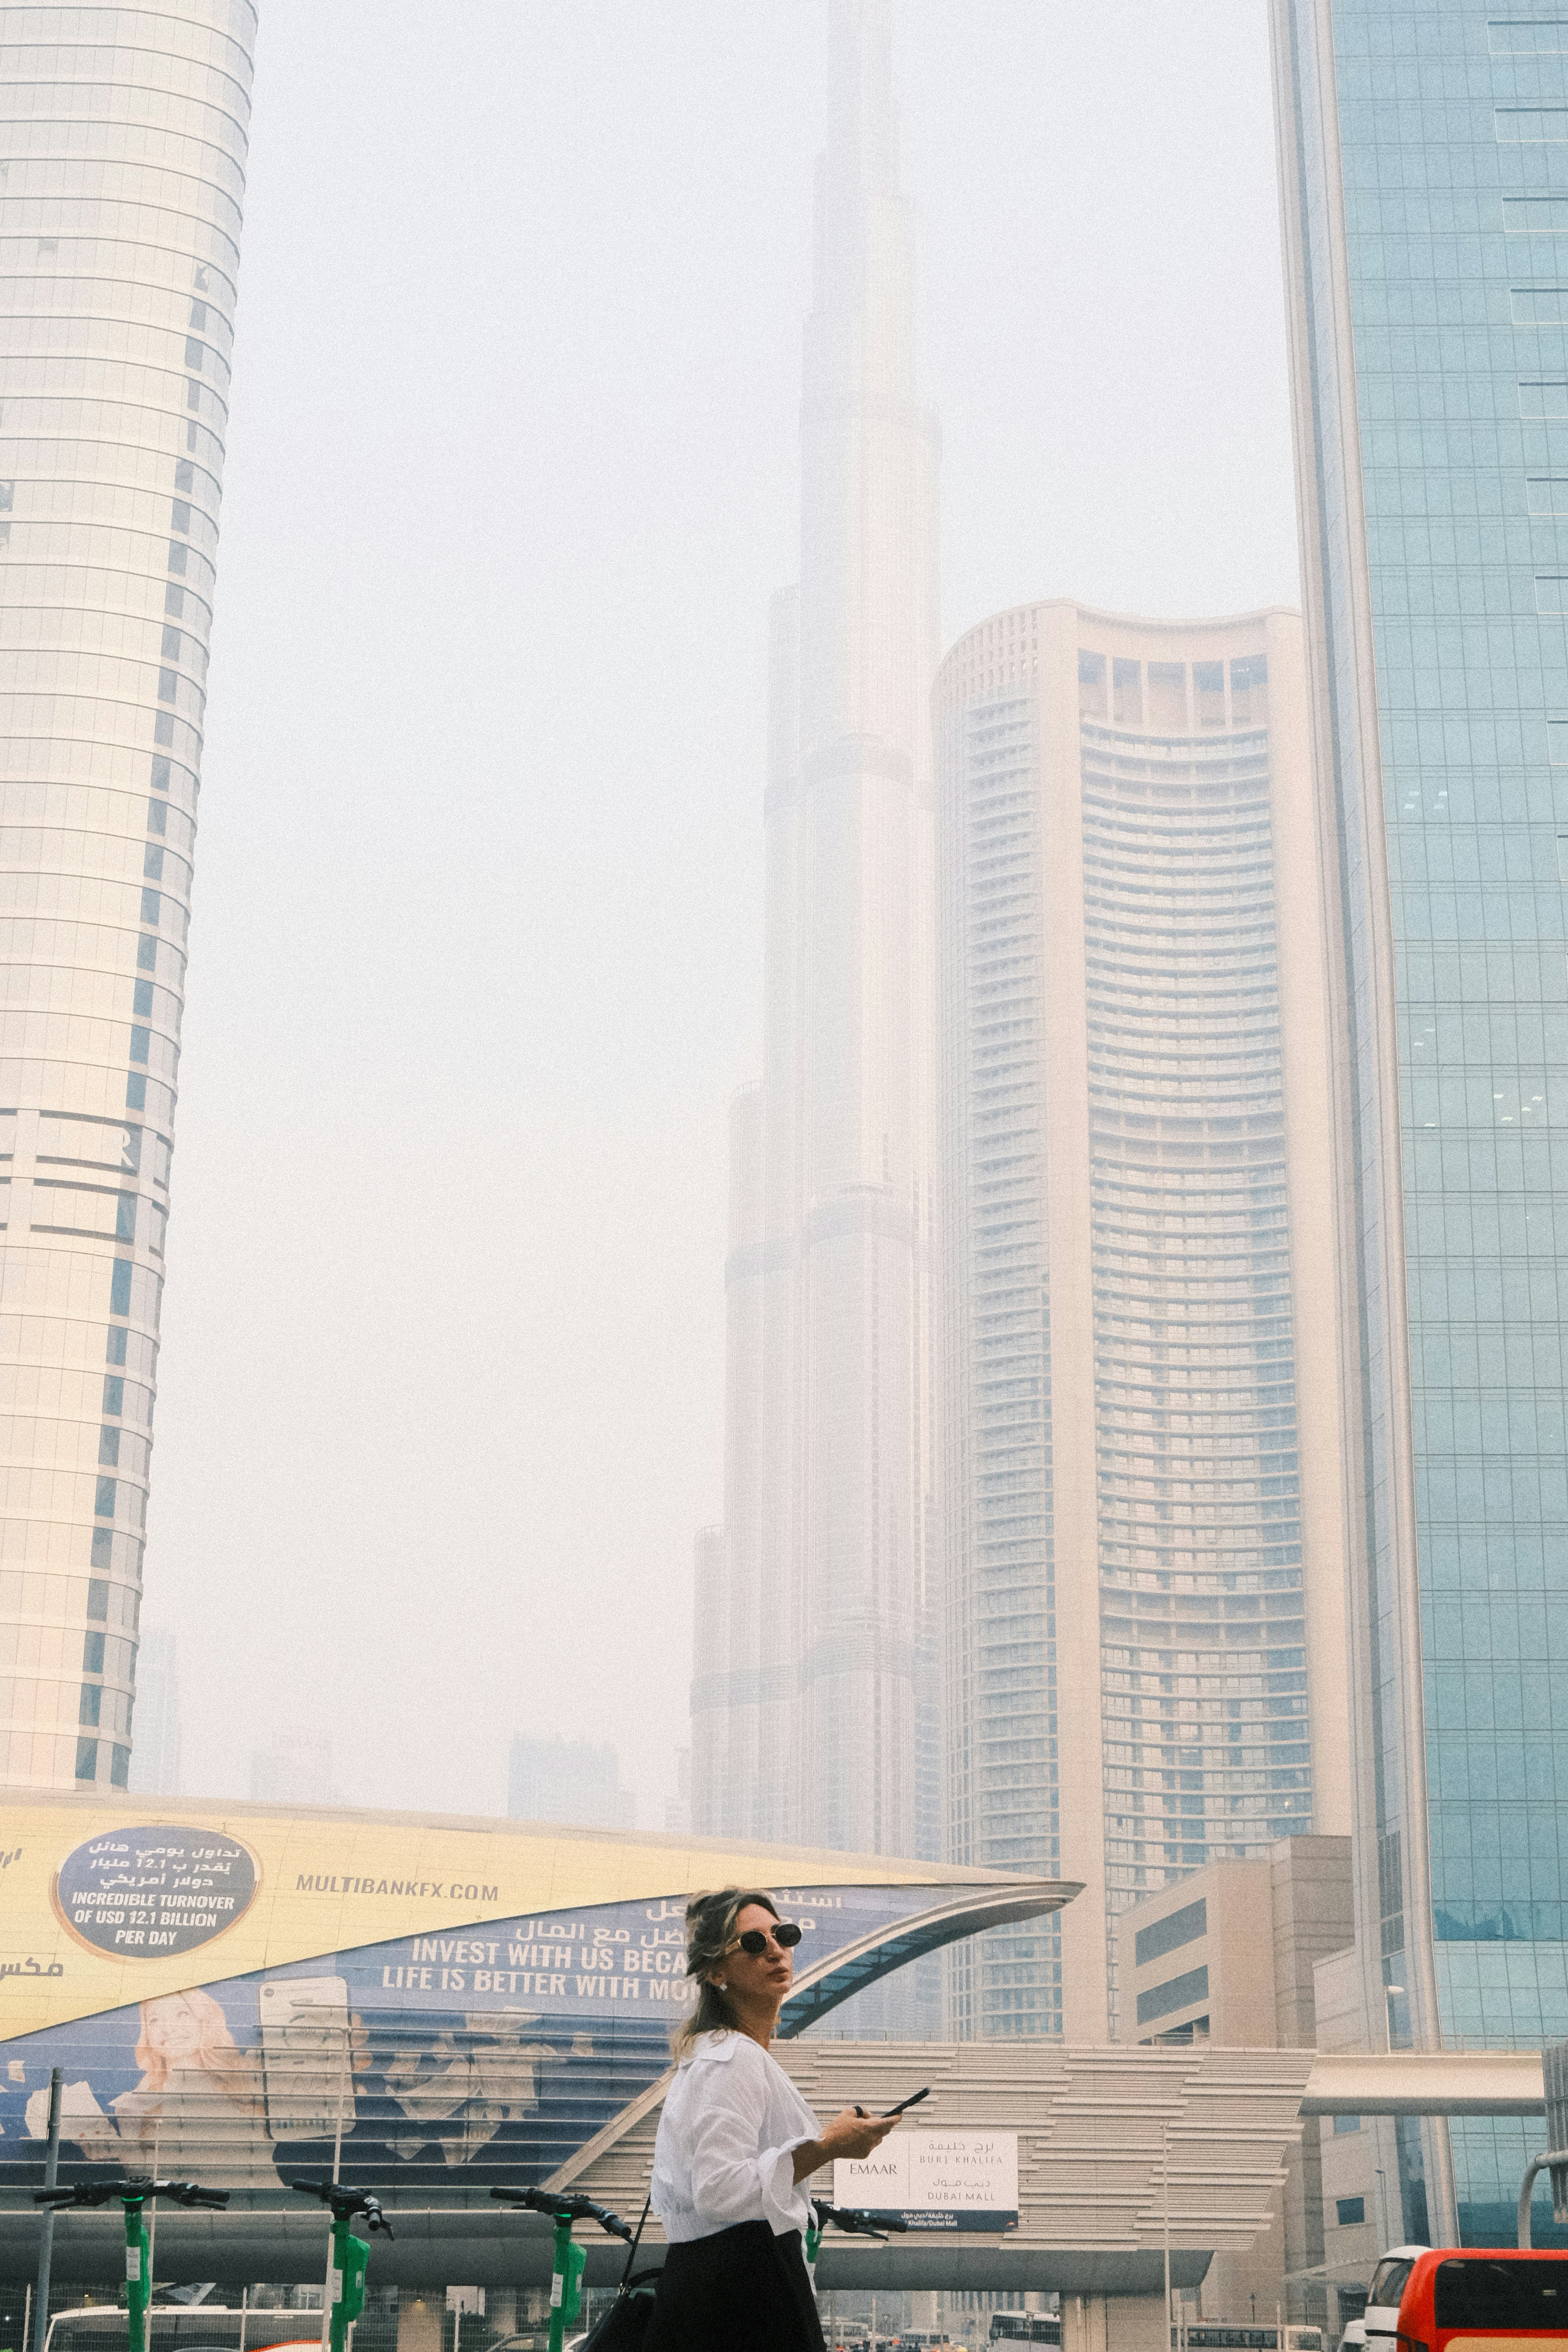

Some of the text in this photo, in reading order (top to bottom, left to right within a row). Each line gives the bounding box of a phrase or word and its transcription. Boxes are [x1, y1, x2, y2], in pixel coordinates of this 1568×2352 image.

[89, 1841, 242, 1859] تداول يومي هائل
[90, 1857, 130, 1870] مليار
[136, 1858, 166, 1869] 12.1
[100, 1873, 213, 1889] دولار أمريكي
[296, 1875, 498, 1901] MULTIBANKFX.COM
[72, 1892, 234, 1909] INCREDIBLE TURNOVER
[74, 1910, 217, 1927] OF USD 12.1 BILLION
[115, 1930, 178, 1945] PER DAY
[516, 1920, 584, 1940] المال
[593, 1928, 630, 1947] مع
[412, 1938, 688, 1974] INVEST WITH US BECA
[383, 1966, 432, 1989] LIFE
[442, 1968, 465, 1991] IS
[474, 1969, 567, 1995] BETTER
[576, 1975, 640, 1999] WITH
[920, 2156, 947, 2164] BURJ
[850, 2164, 897, 2174] EMAAR
